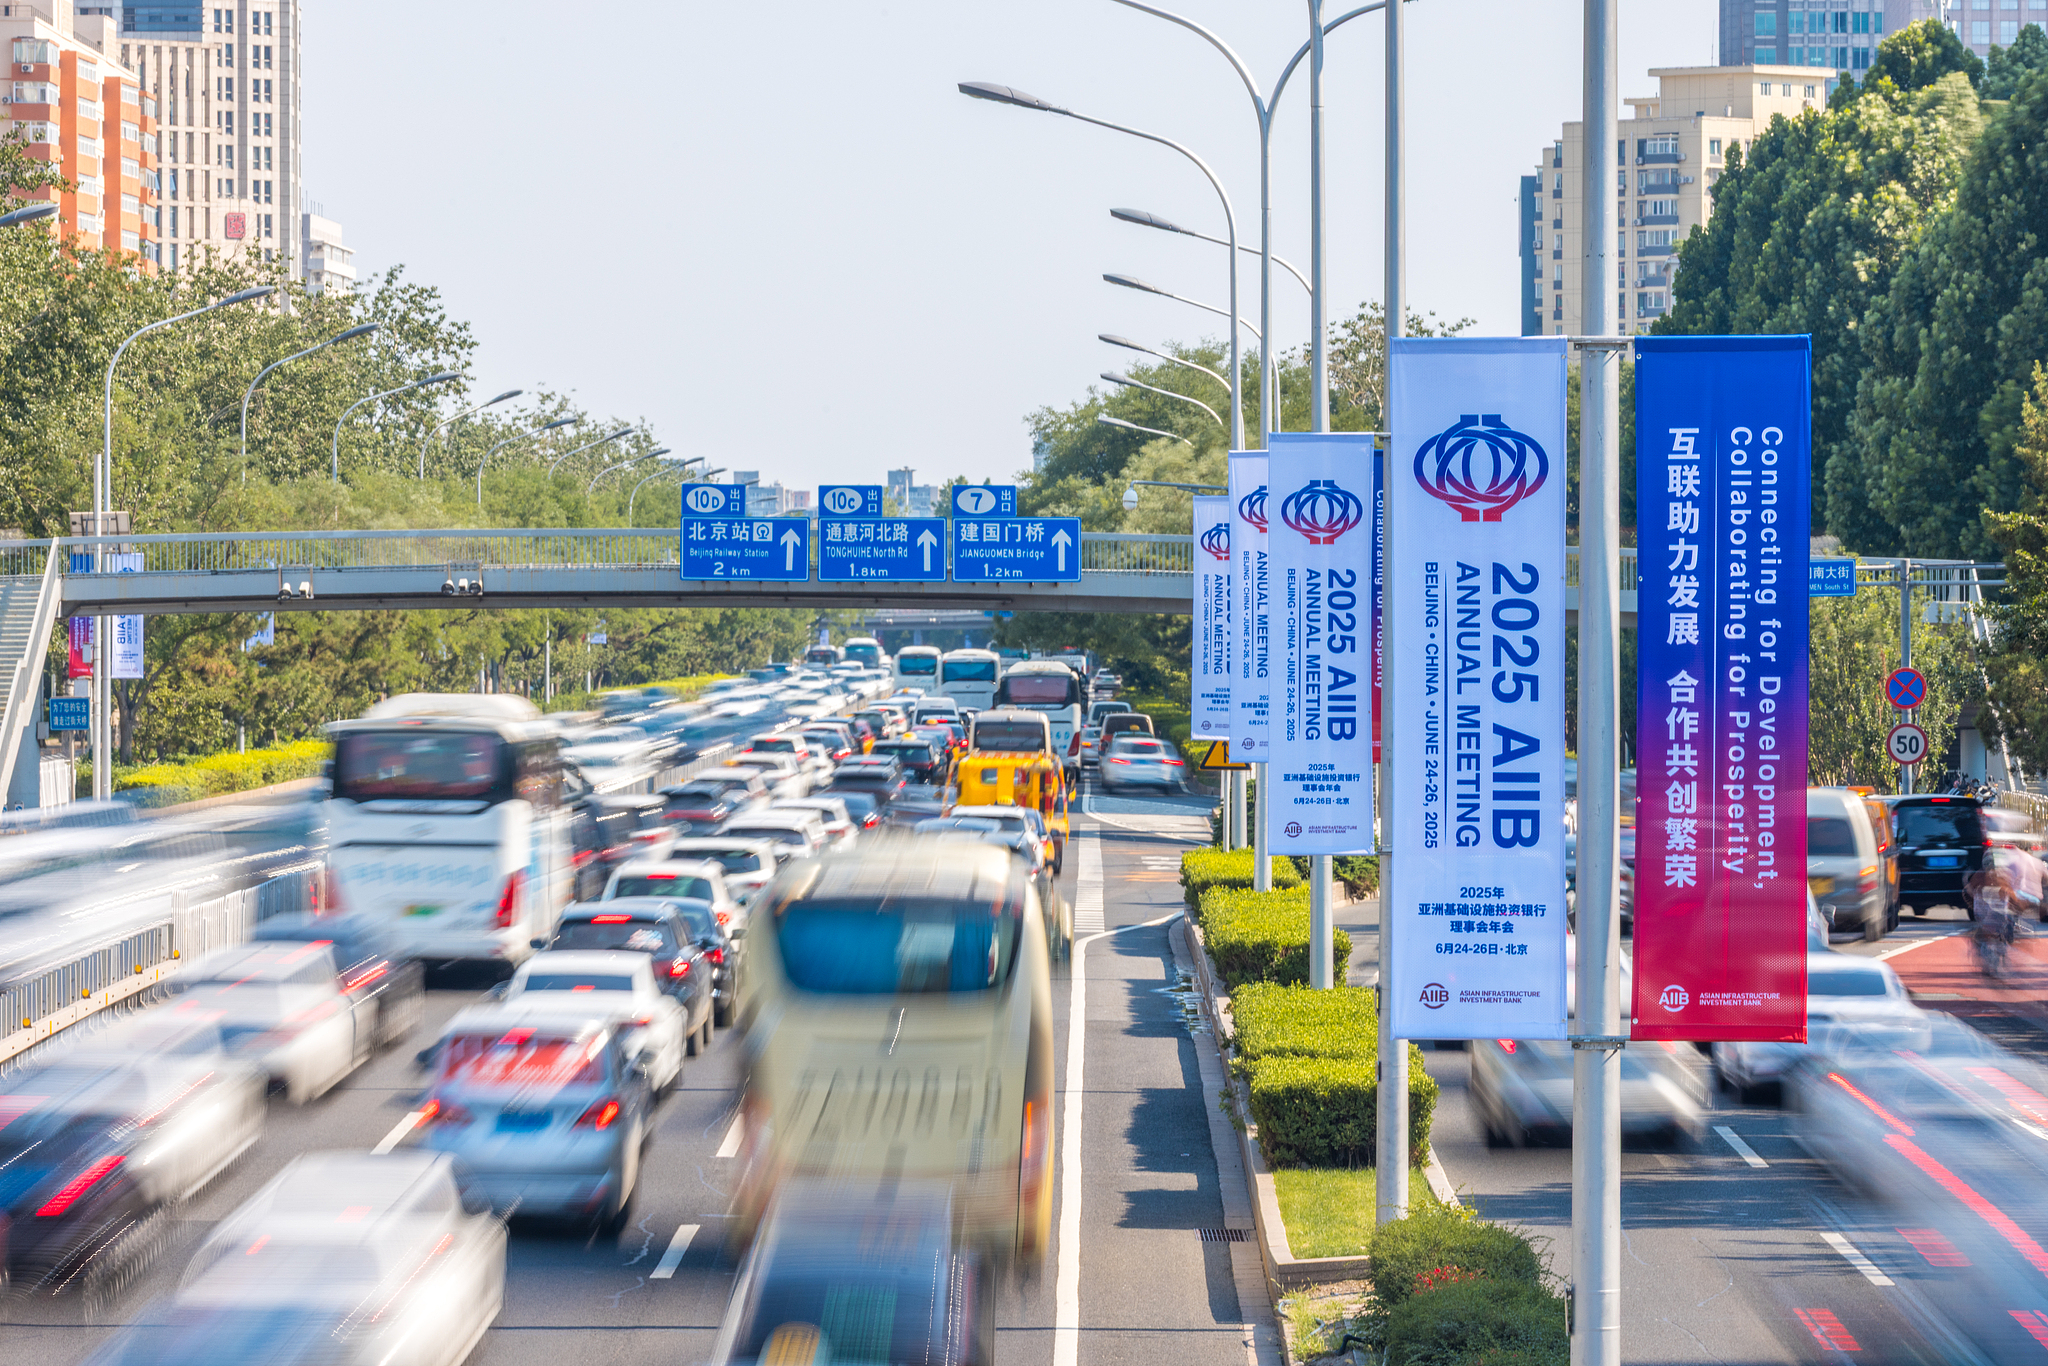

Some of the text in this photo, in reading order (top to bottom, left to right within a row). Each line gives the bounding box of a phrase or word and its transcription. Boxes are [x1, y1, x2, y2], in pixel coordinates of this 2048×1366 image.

[694, 490, 720, 508] 10D
[730, 488, 740, 512] 出口
[867, 489, 877, 513] 出口
[970, 493, 983, 511] 7
[1001, 489, 1011, 512] 出口
[688, 522, 750, 541] 北京站
[826, 522, 909, 542] 通惠河北路
[960, 522, 1045, 542] 建国门桥
[690, 548, 769, 559] Beijing Railway Station
[826, 546, 908, 558] TONGHUIHE North Rd
[960, 549, 1045, 561] JIANGUOMEN Bridge
[713, 562, 750, 576] 2 km
[1809, 565, 1849, 579] 南大街
[1824, 583, 1840, 591] South
[1842, 583, 1849, 591] St
[1257, 551, 1268, 678] ANNUAL MEETING
[1214, 574, 1223, 675] ANNUAL MEETING
[1286, 568, 1296, 742] BEIJING CHINA JUNE 24-26, 2025
[1305, 568, 1321, 741] ANNUAL MEETING
[1327, 568, 1357, 741] 2025 AIIB
[1664, 427, 1700, 888] 互联助力发展 合作共创繁荣
[1722, 426, 1752, 874] Collaborating for Prosperity
[1753, 426, 1783, 889] Connecting for Development,
[1422, 561, 1439, 849] BEIJING CHINA JUNE 24-26, 2025
[1456, 561, 1481, 847] ANNUAL MEETING
[1491, 562, 1540, 849] 2025 AIIB
[1896, 735, 1919, 754] 50
[1308, 763, 1335, 771] 2025年
[1460, 886, 1505, 899] 2025年
[1418, 903, 1546, 917] 亚洲基础设施投资银行
[1450, 920, 1514, 933] 理事会年会
[1418, 990, 1449, 1002] AIIB
[1658, 992, 1689, 1005] AIIB
